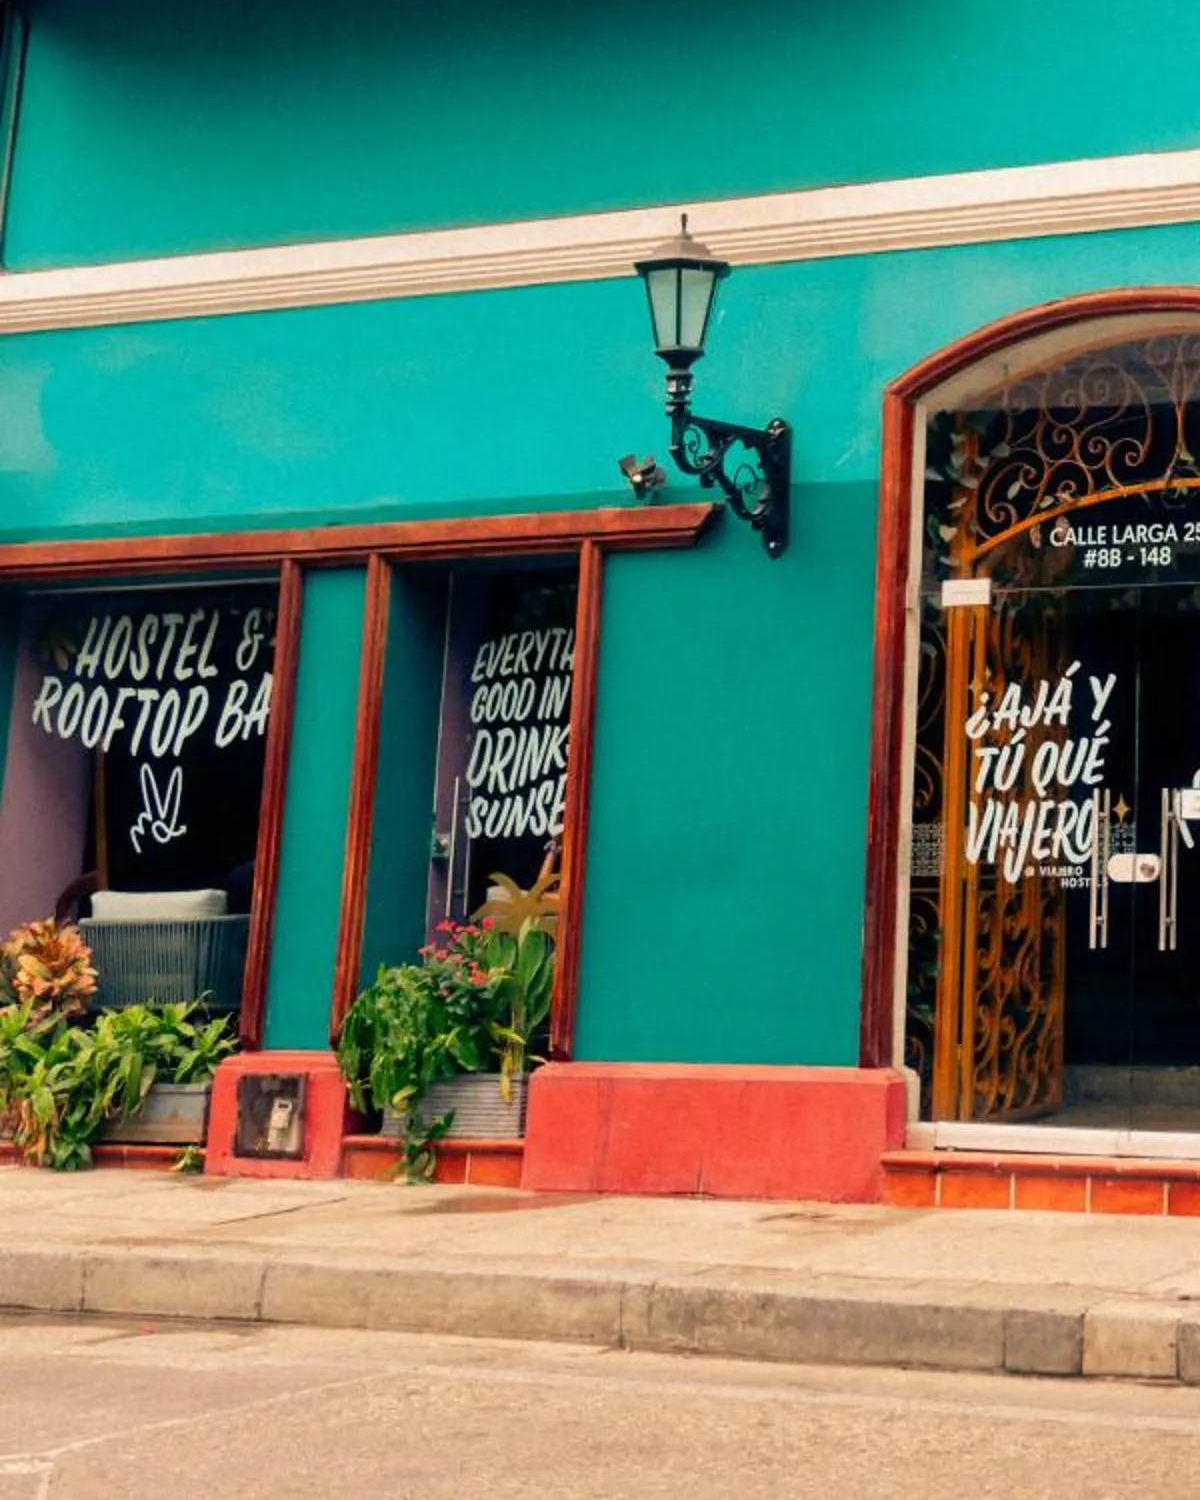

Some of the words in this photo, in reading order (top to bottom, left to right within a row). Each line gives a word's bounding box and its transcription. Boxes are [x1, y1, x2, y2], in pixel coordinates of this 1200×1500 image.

[1049, 525, 1107, 547] CALLE
[1112, 522, 1178, 544] LARGA
[1083, 547, 1122, 568] #8B
[1139, 546, 1172, 567] 148
[75, 609, 219, 681] HOSTEL
[235, 608, 264, 671] &
[31, 676, 209, 757] ROOFTOP
[215, 672, 273, 748] BA
[470, 678, 536, 724] GOOD
[537, 675, 570, 720] IN
[965, 660, 1081, 739] ¿AJÁ
[1089, 673, 1117, 721] Y
[466, 724, 571, 794] DRINK
[975, 728, 1026, 793] TÚ
[1031, 719, 1112, 798] QUÉ
[965, 799, 1096, 883] VIAJERO
